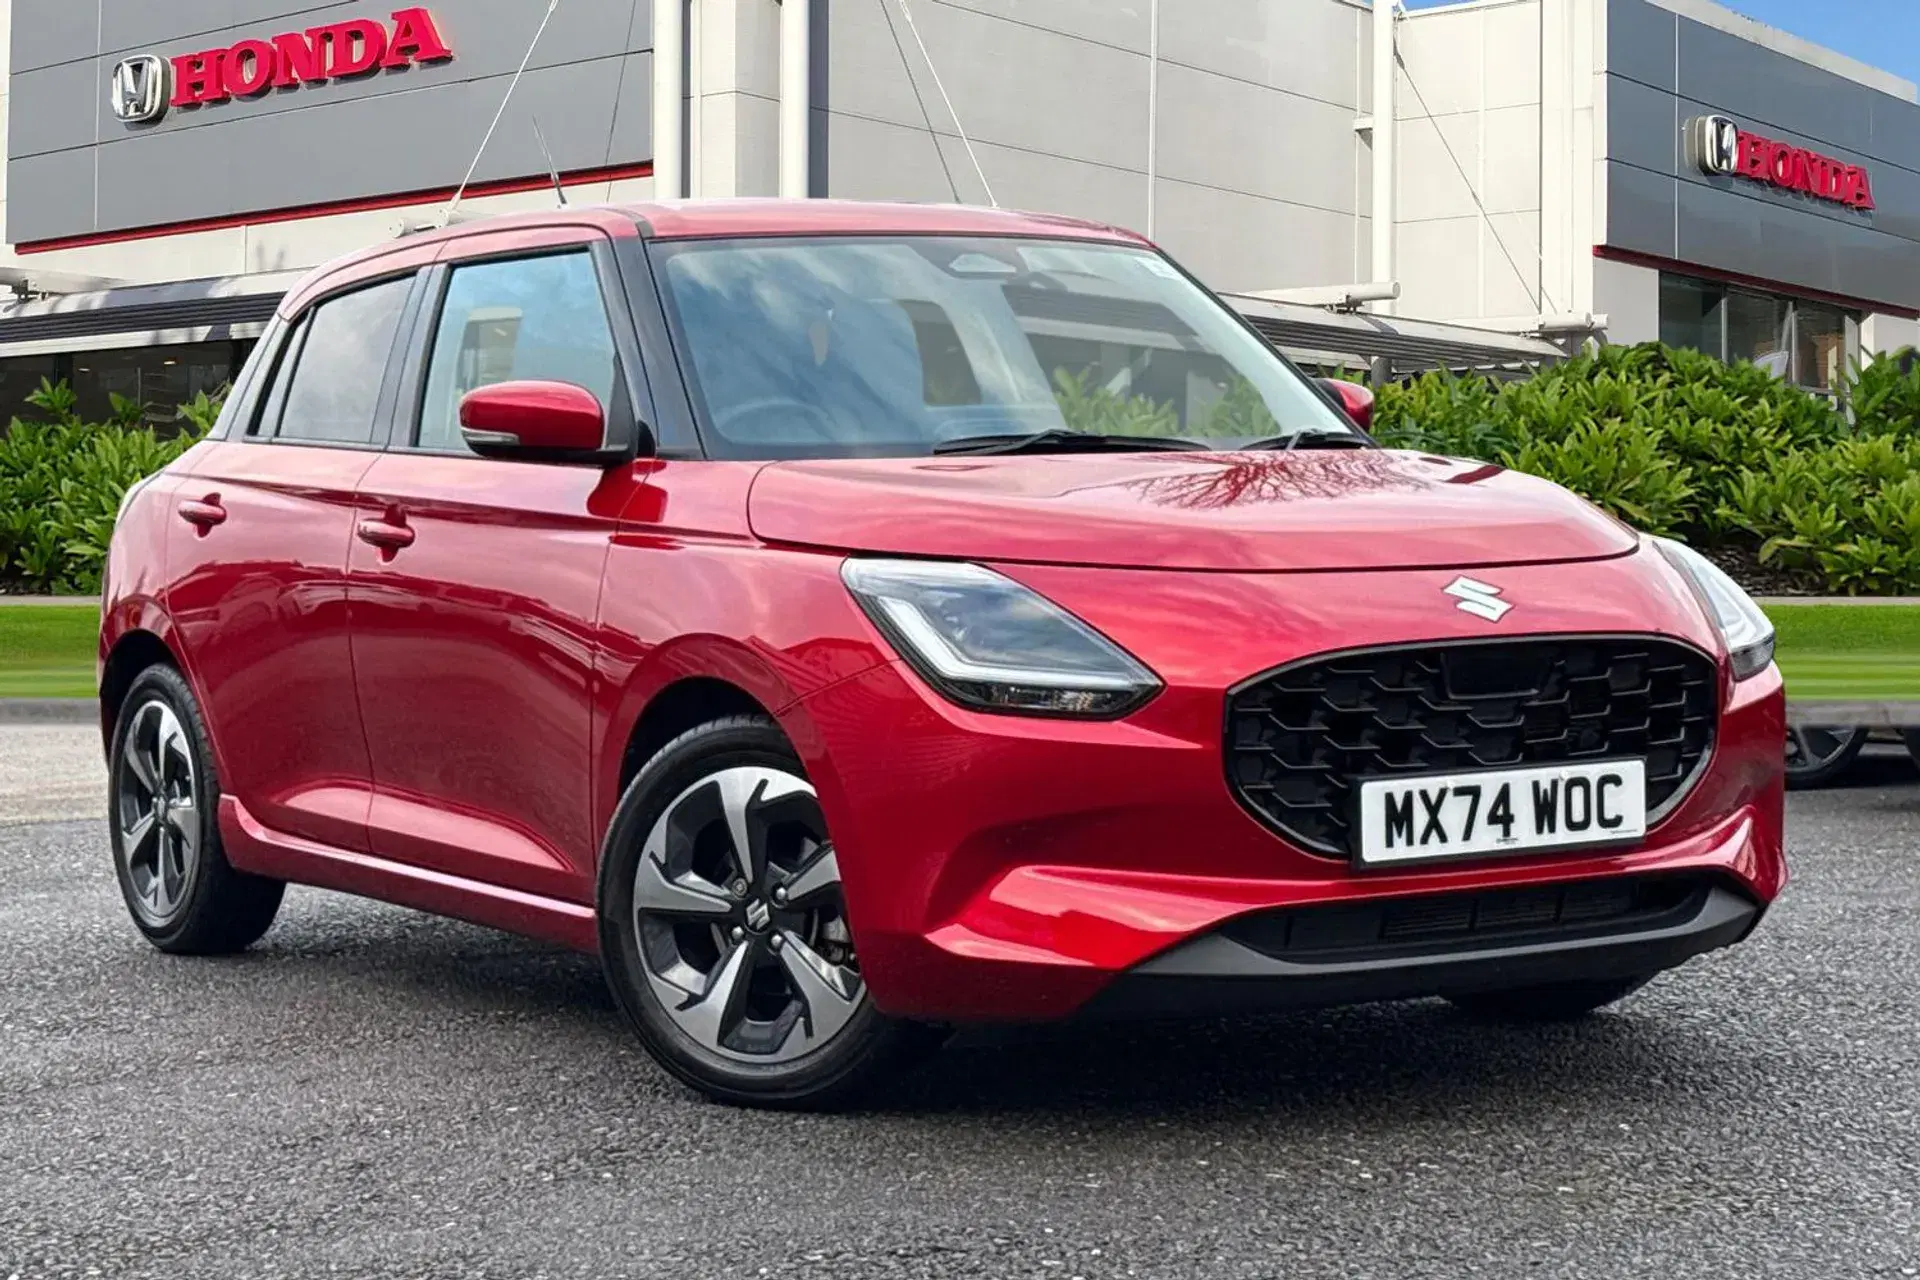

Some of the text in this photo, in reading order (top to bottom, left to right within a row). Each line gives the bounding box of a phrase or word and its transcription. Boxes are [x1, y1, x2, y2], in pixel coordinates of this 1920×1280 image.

[170, 7, 453, 107] HONDA
[1737, 130, 1875, 210] HONDA
[1384, 773, 1624, 848] MX74 WOC
